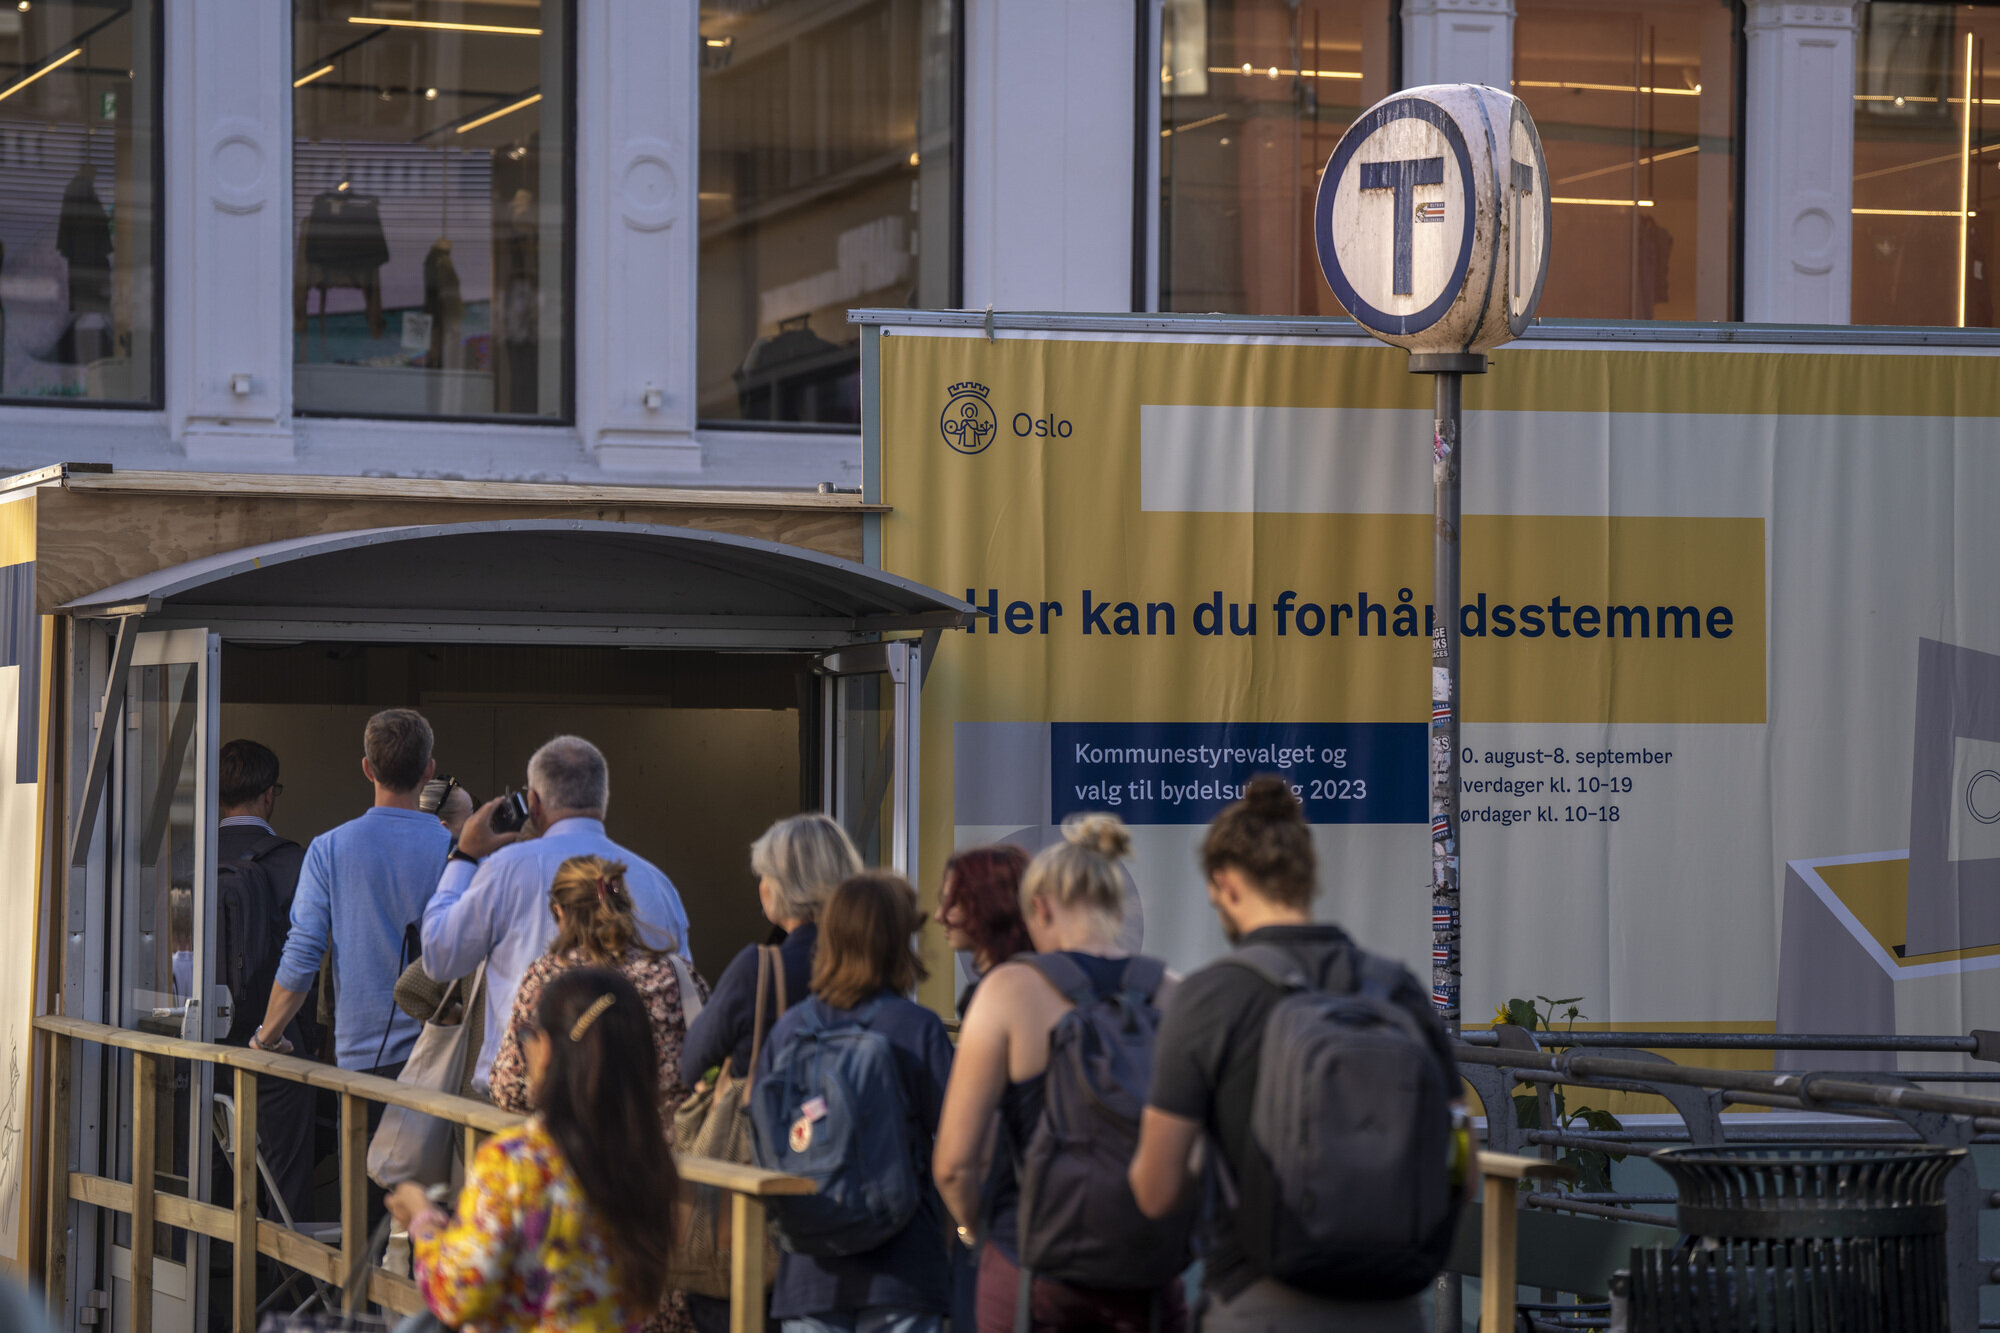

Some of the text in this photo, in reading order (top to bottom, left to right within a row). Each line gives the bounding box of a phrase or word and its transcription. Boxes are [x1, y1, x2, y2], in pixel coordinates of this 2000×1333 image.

[1360, 157, 1444, 296] T
[1012, 412, 1073, 438] Oslo
[965, 588, 1063, 635] Her
[1082, 590, 1176, 636] kan
[1193, 591, 1257, 636] du
[1075, 743, 1347, 768] Kommunestyrevalget og
[1484, 748, 1570, 768] august–8.
[1575, 748, 1673, 768] september
[1075, 779, 1367, 805] valg til bydelsug 2023
[1550, 776, 1571, 793] kl.
[1578, 777, 1633, 793] 10–19
[1460, 806, 1532, 826] ørdager
[1537, 806, 1559, 822] kl.
[1565, 806, 1620, 822] 10–18
